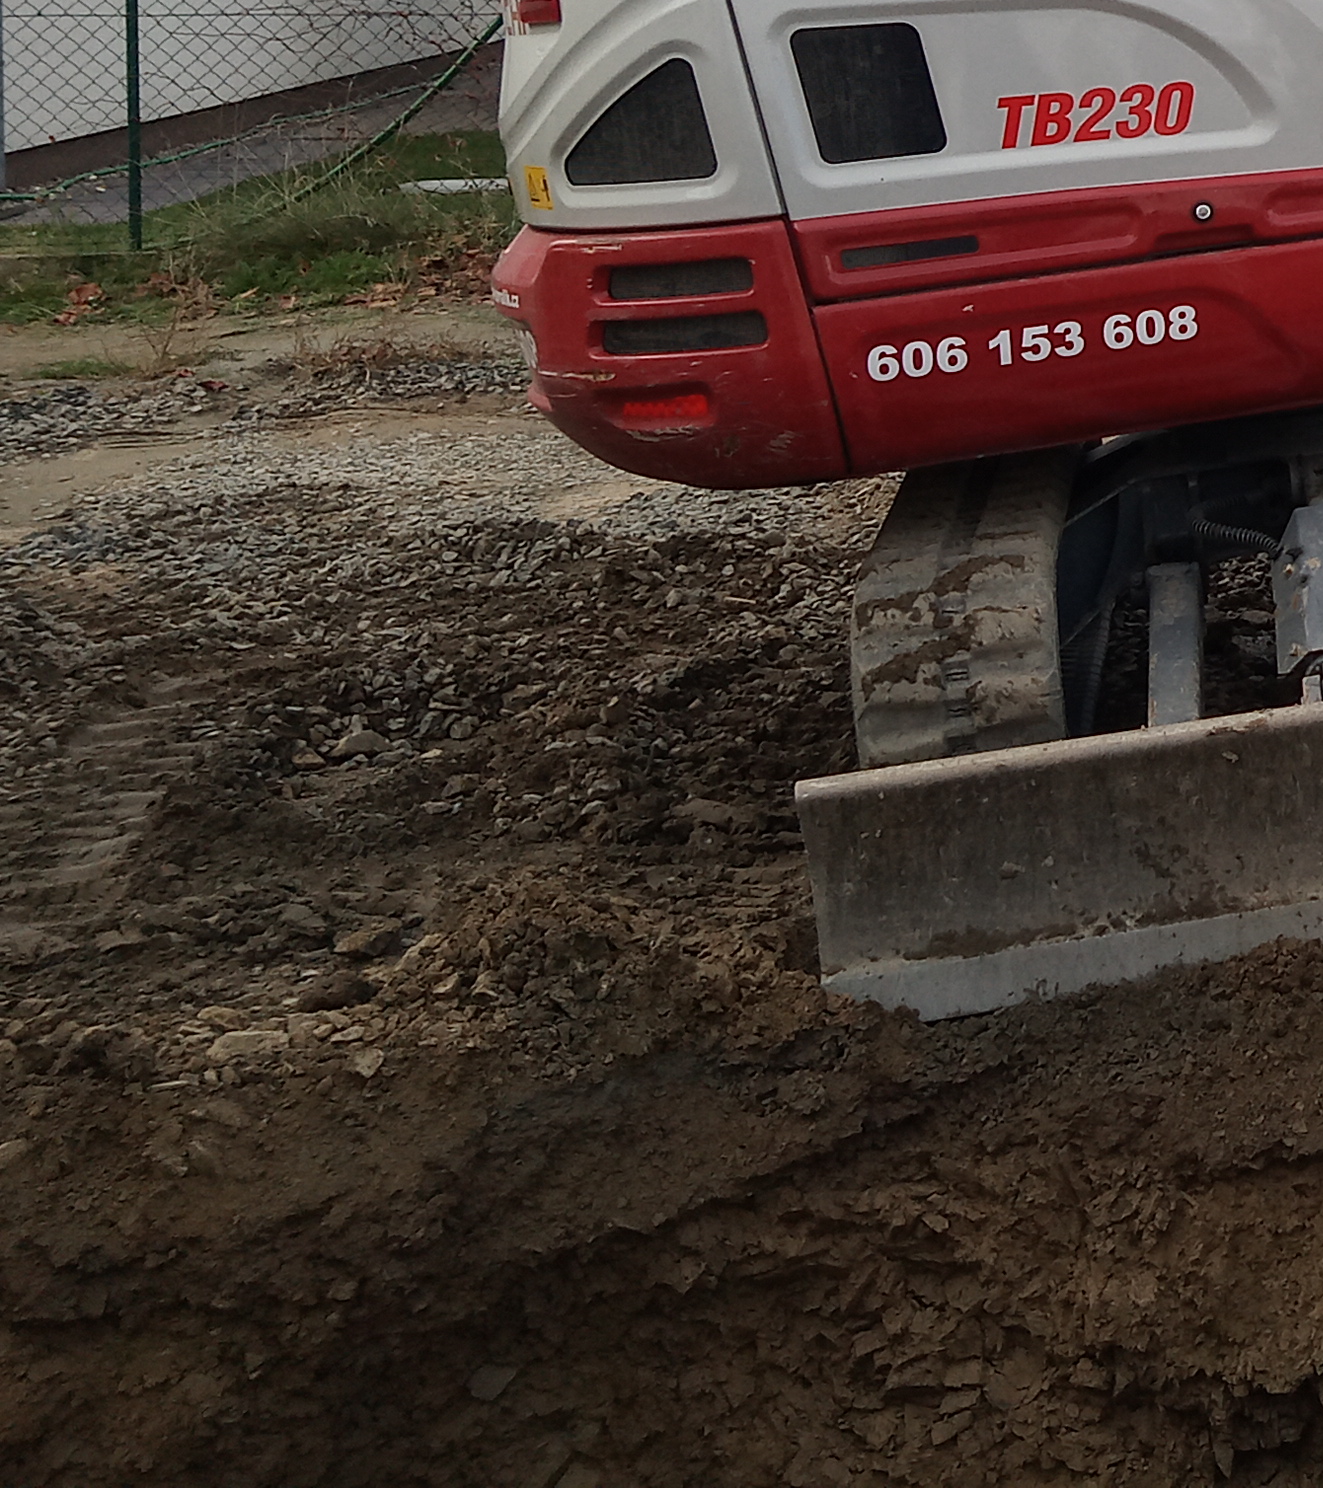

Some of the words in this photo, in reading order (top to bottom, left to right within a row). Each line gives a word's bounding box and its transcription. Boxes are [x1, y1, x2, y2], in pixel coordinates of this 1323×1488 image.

[996, 80, 1195, 150] TB230
[866, 336, 969, 382] 606
[987, 321, 1085, 366] 153
[1102, 305, 1198, 350] 608
